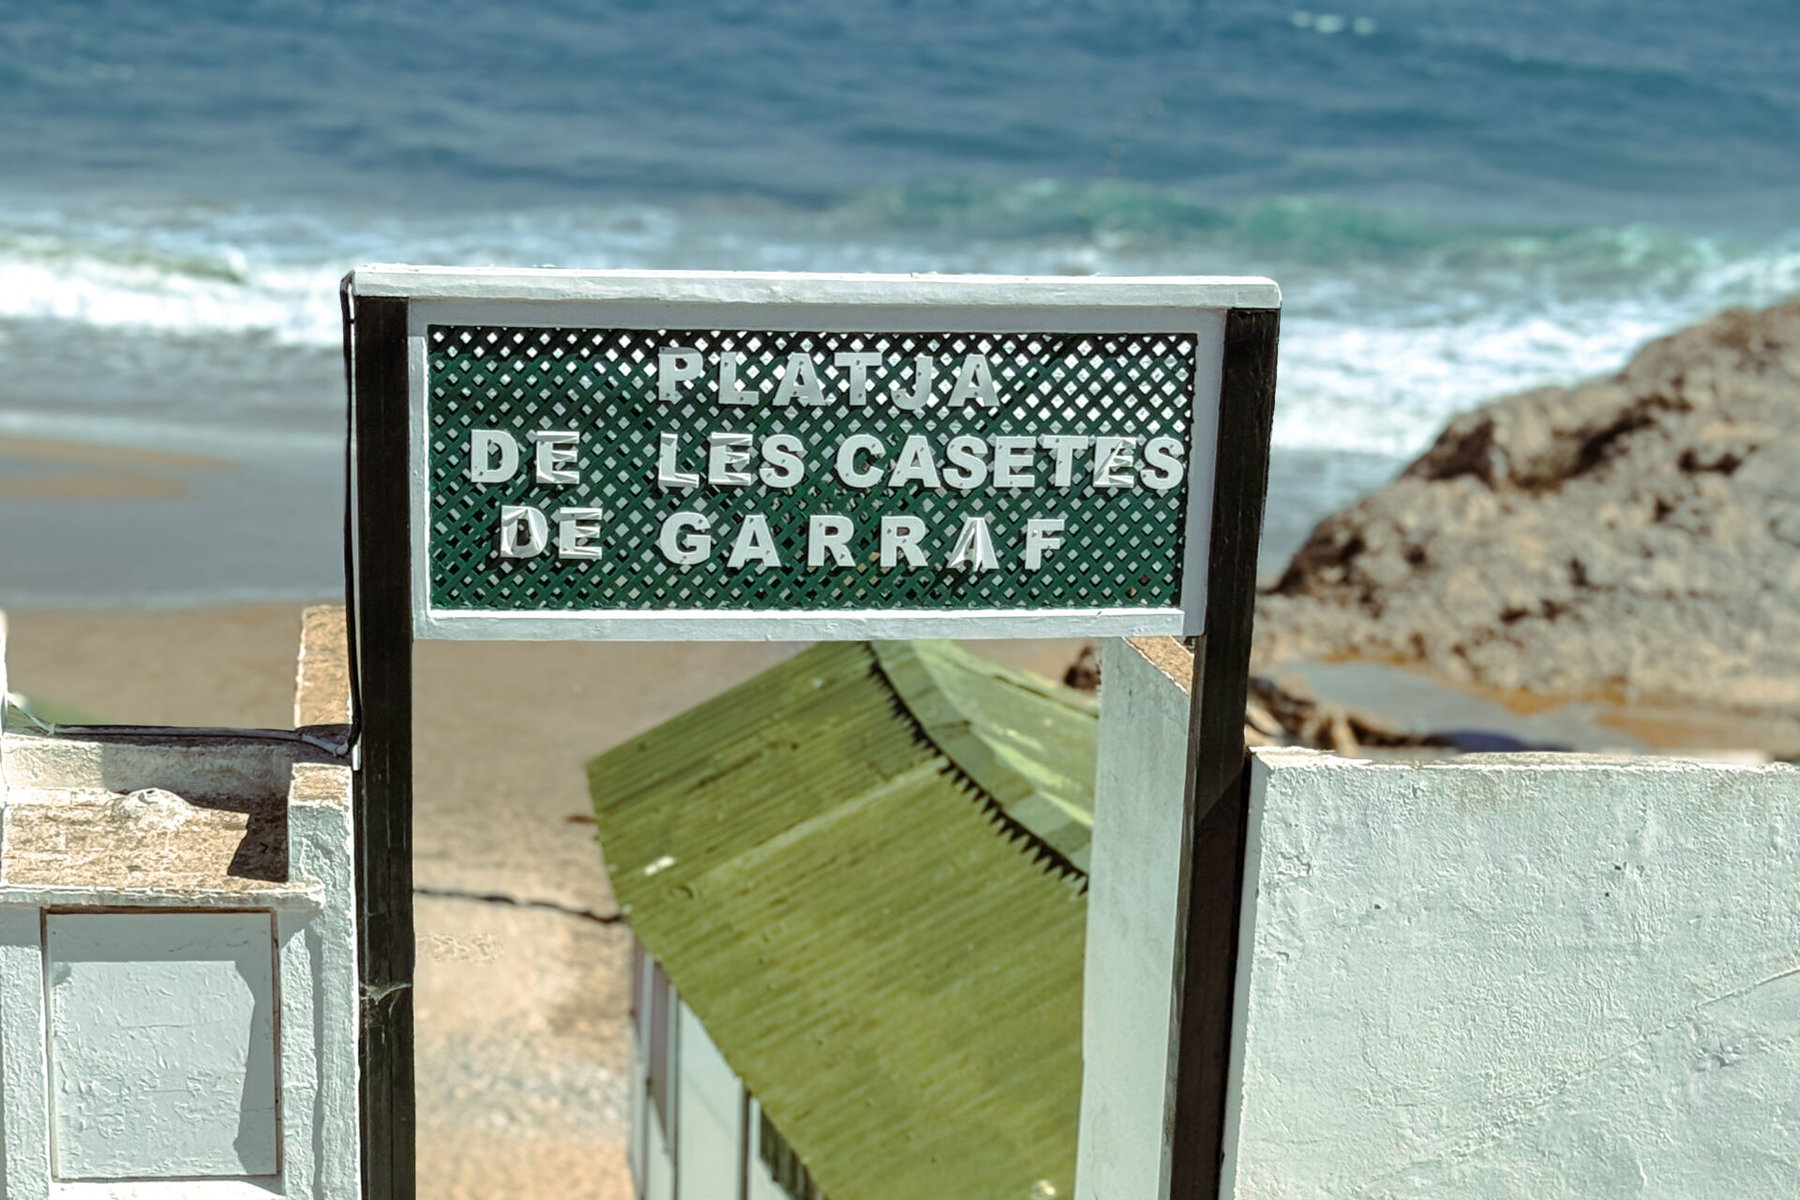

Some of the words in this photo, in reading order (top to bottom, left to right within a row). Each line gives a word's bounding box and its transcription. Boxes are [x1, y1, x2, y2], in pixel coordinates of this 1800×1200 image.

[657, 346, 1001, 408] PLATJA
[470, 429, 582, 485] DE
[658, 432, 805, 490] LES
[836, 435, 1185, 490] CASETES
[500, 505, 603, 560] DE
[659, 513, 1066, 571] GARRAF
